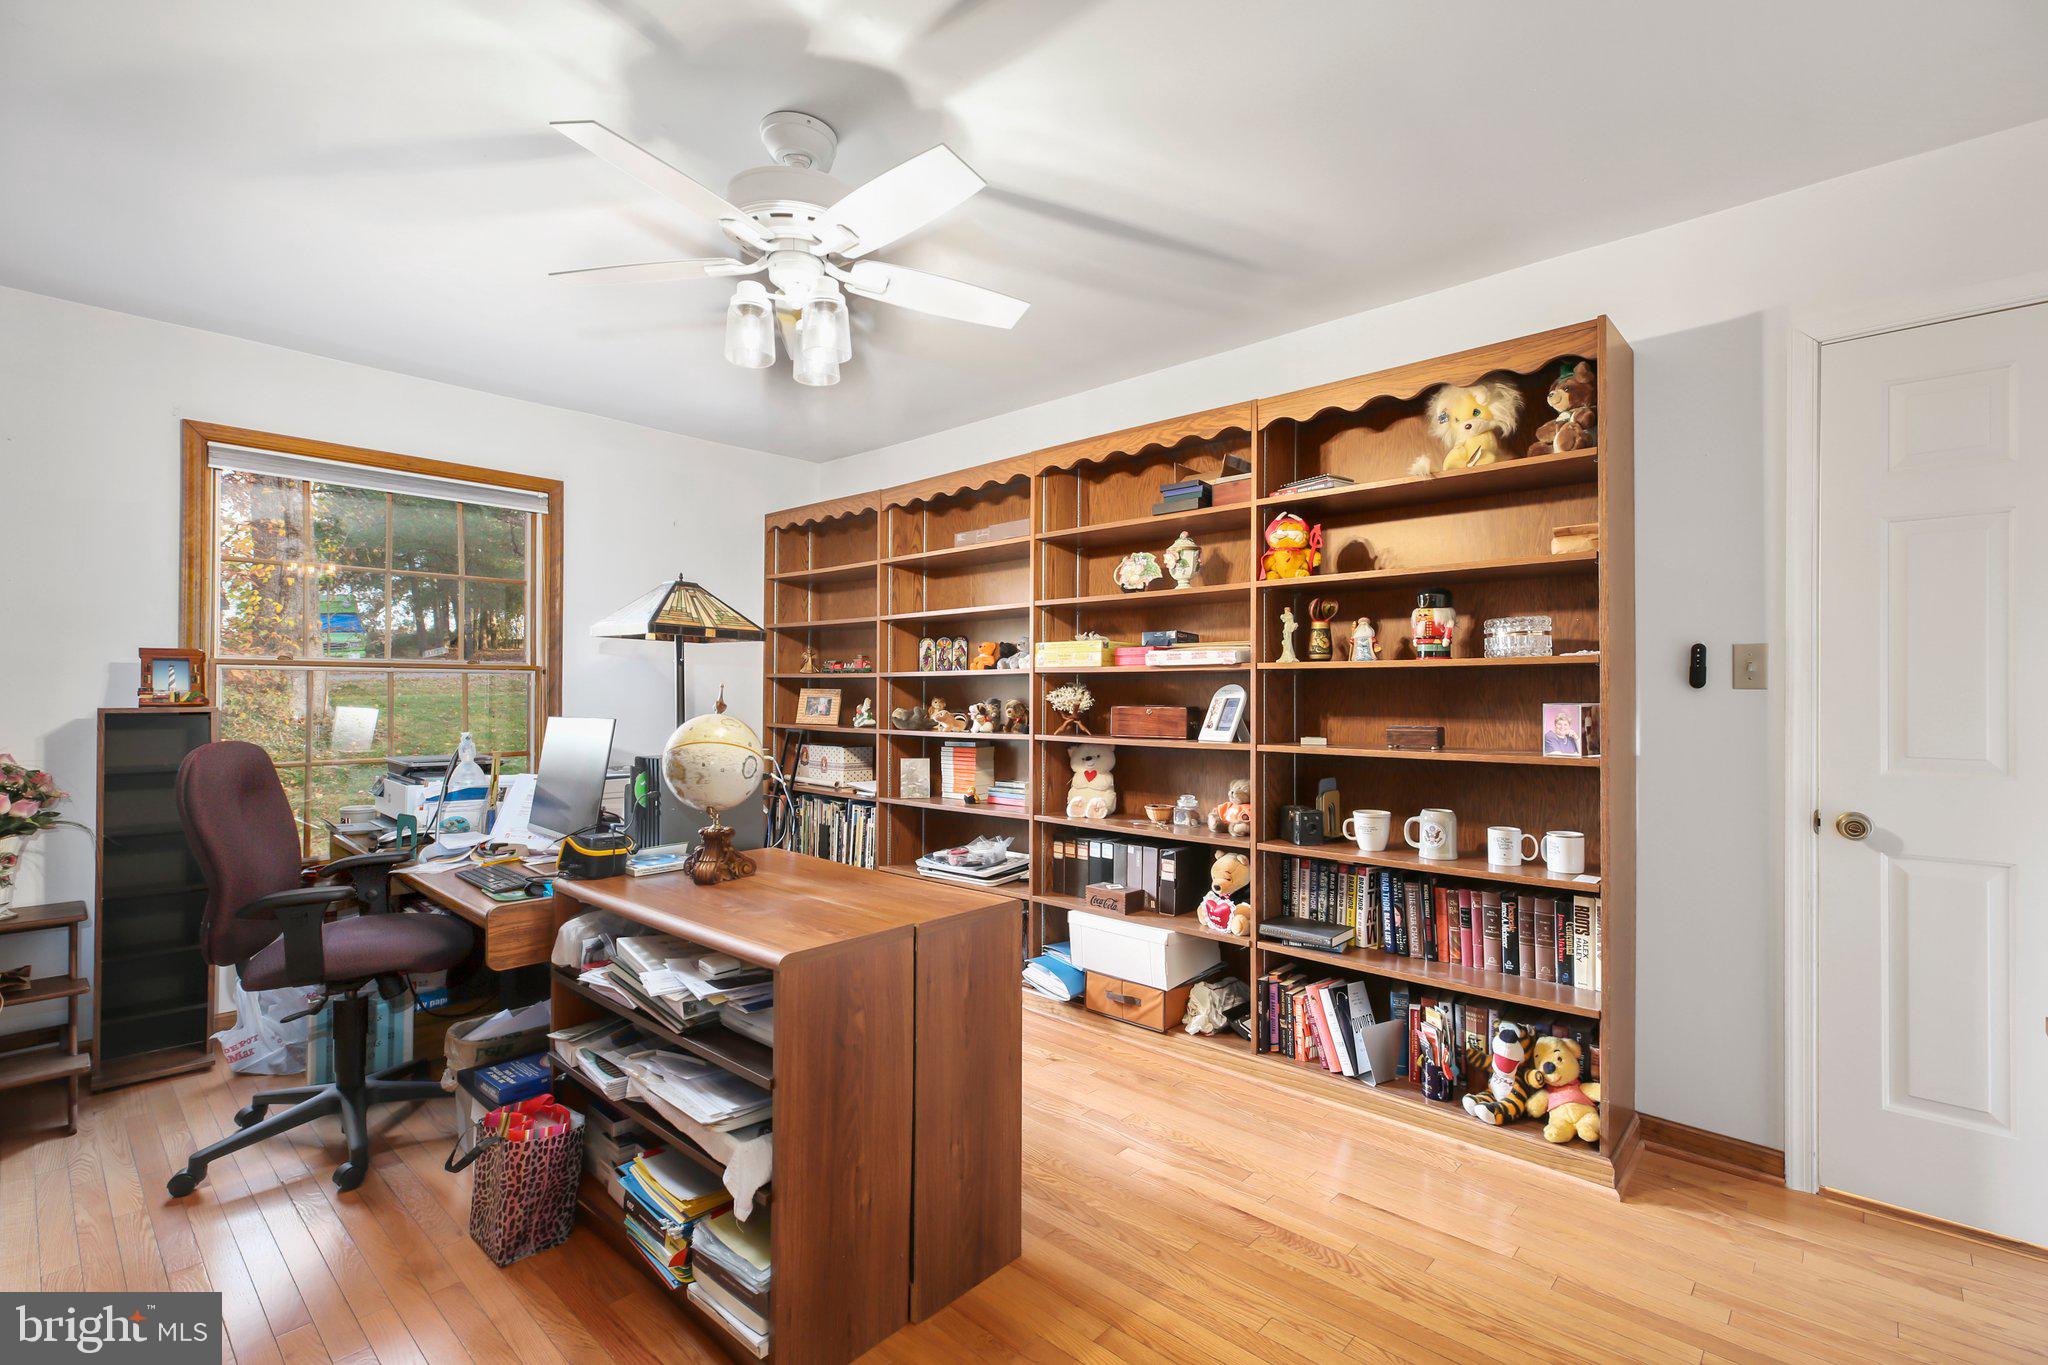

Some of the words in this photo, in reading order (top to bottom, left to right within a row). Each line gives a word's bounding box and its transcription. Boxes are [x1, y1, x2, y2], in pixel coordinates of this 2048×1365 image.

[1382, 872, 1390, 891] BRAD
[1382, 892, 1391, 911] THOR
[1383, 912, 1391, 931] BLACK
[1409, 903, 1417, 926] SILVER
[1575, 905, 1590, 936] ROOTS
[1565, 921, 1574, 955] Centennial
[1575, 937, 1583, 963] HALEY
